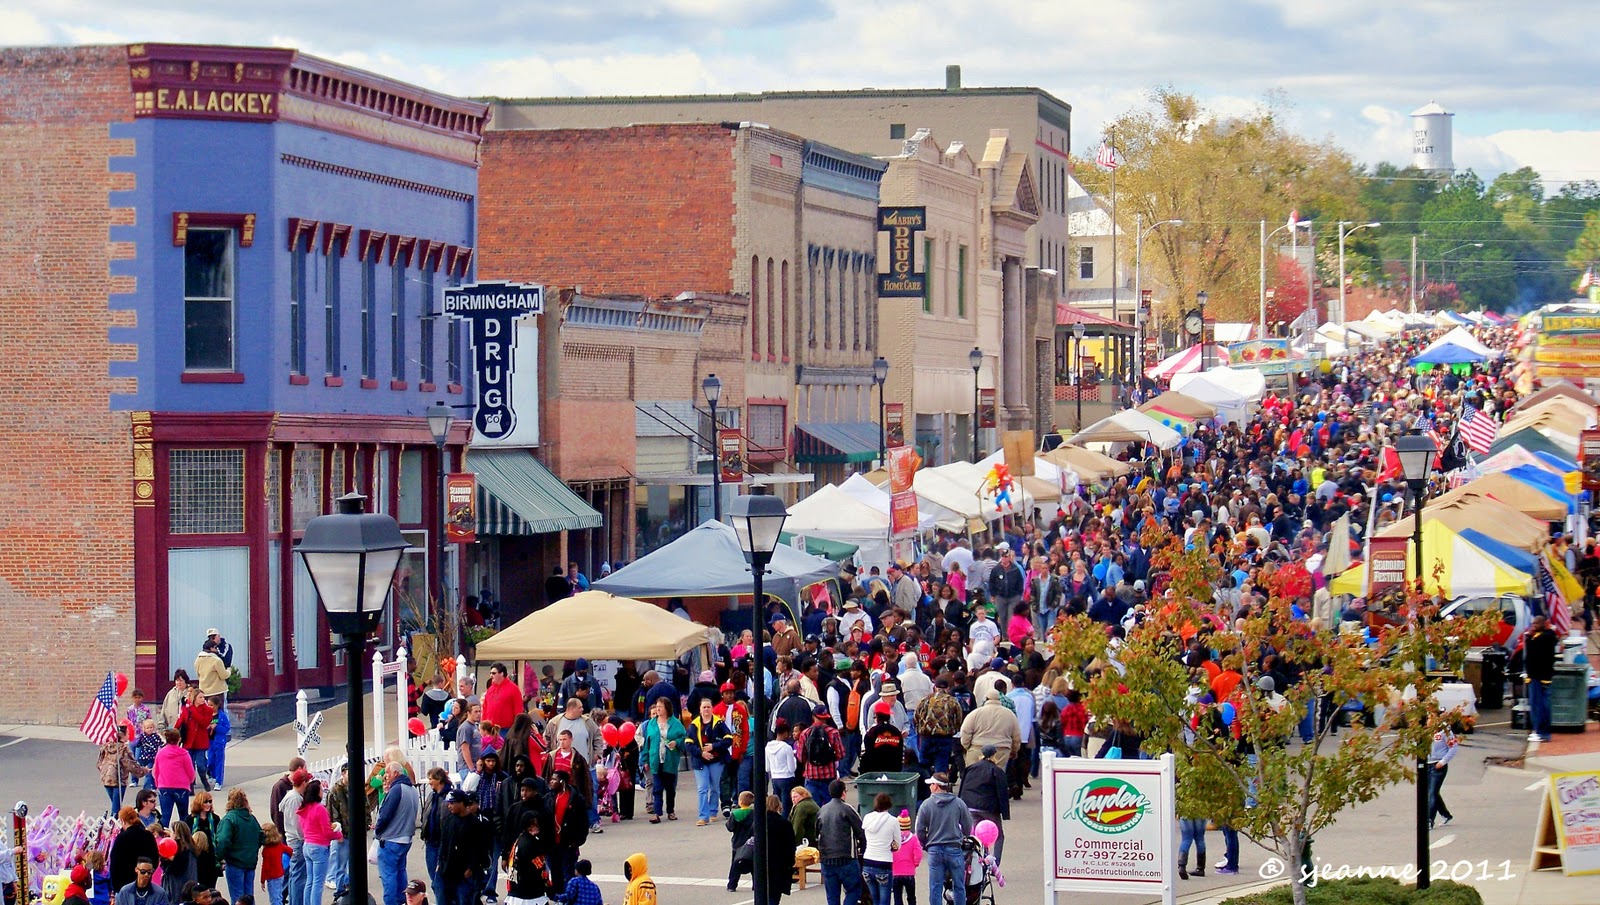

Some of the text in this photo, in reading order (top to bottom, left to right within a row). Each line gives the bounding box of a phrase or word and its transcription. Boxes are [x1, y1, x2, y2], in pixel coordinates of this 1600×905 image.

[895, 227, 909, 273] DRUG
[884, 280, 921, 290] HOME CARE
[445, 293, 539, 311] BIRMINGHAM
[484, 318, 502, 408] DRUG
[1373, 571, 1405, 582] FESTIVAL
[1063, 784, 1151, 822] Hayden
[1081, 812, 1142, 832] CONSTRUCTION
[1074, 837, 1143, 851] Commercial
[1064, 850, 1154, 861] 877-997-2260
[1058, 866, 1162, 877] HaydenConstructionInc.com
